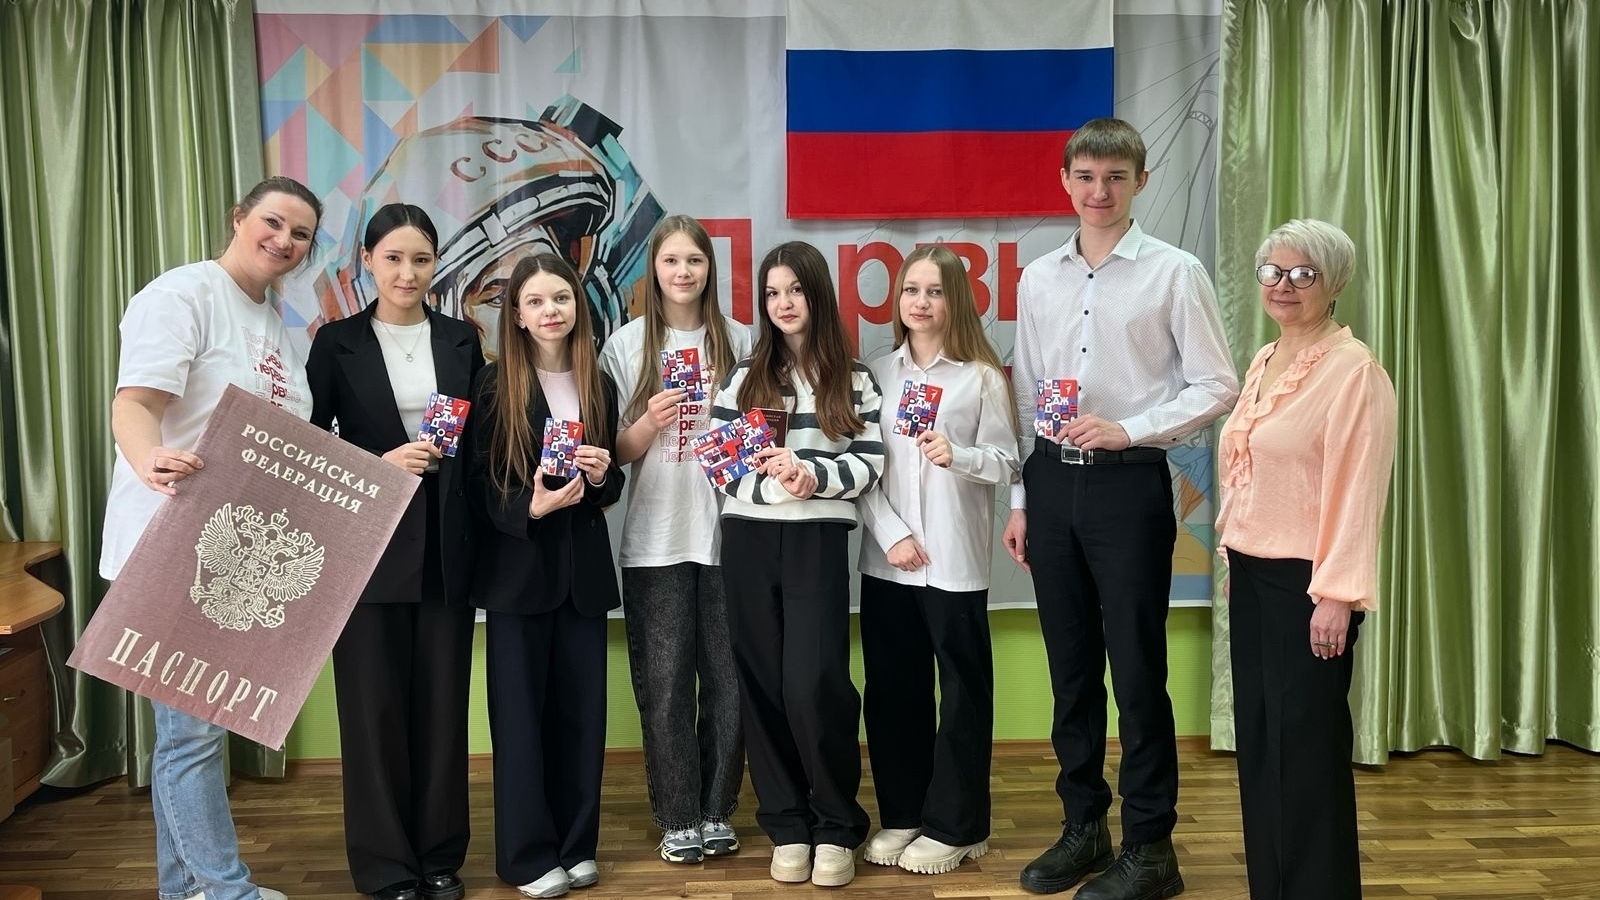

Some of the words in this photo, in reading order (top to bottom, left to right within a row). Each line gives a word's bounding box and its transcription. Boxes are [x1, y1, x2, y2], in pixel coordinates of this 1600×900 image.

[241, 423, 381, 499] РОССИЙСКАЯ
[241, 448, 363, 514] ФЕДЕРАЦИЯ
[107, 627, 278, 722] ПАСПОРТ
